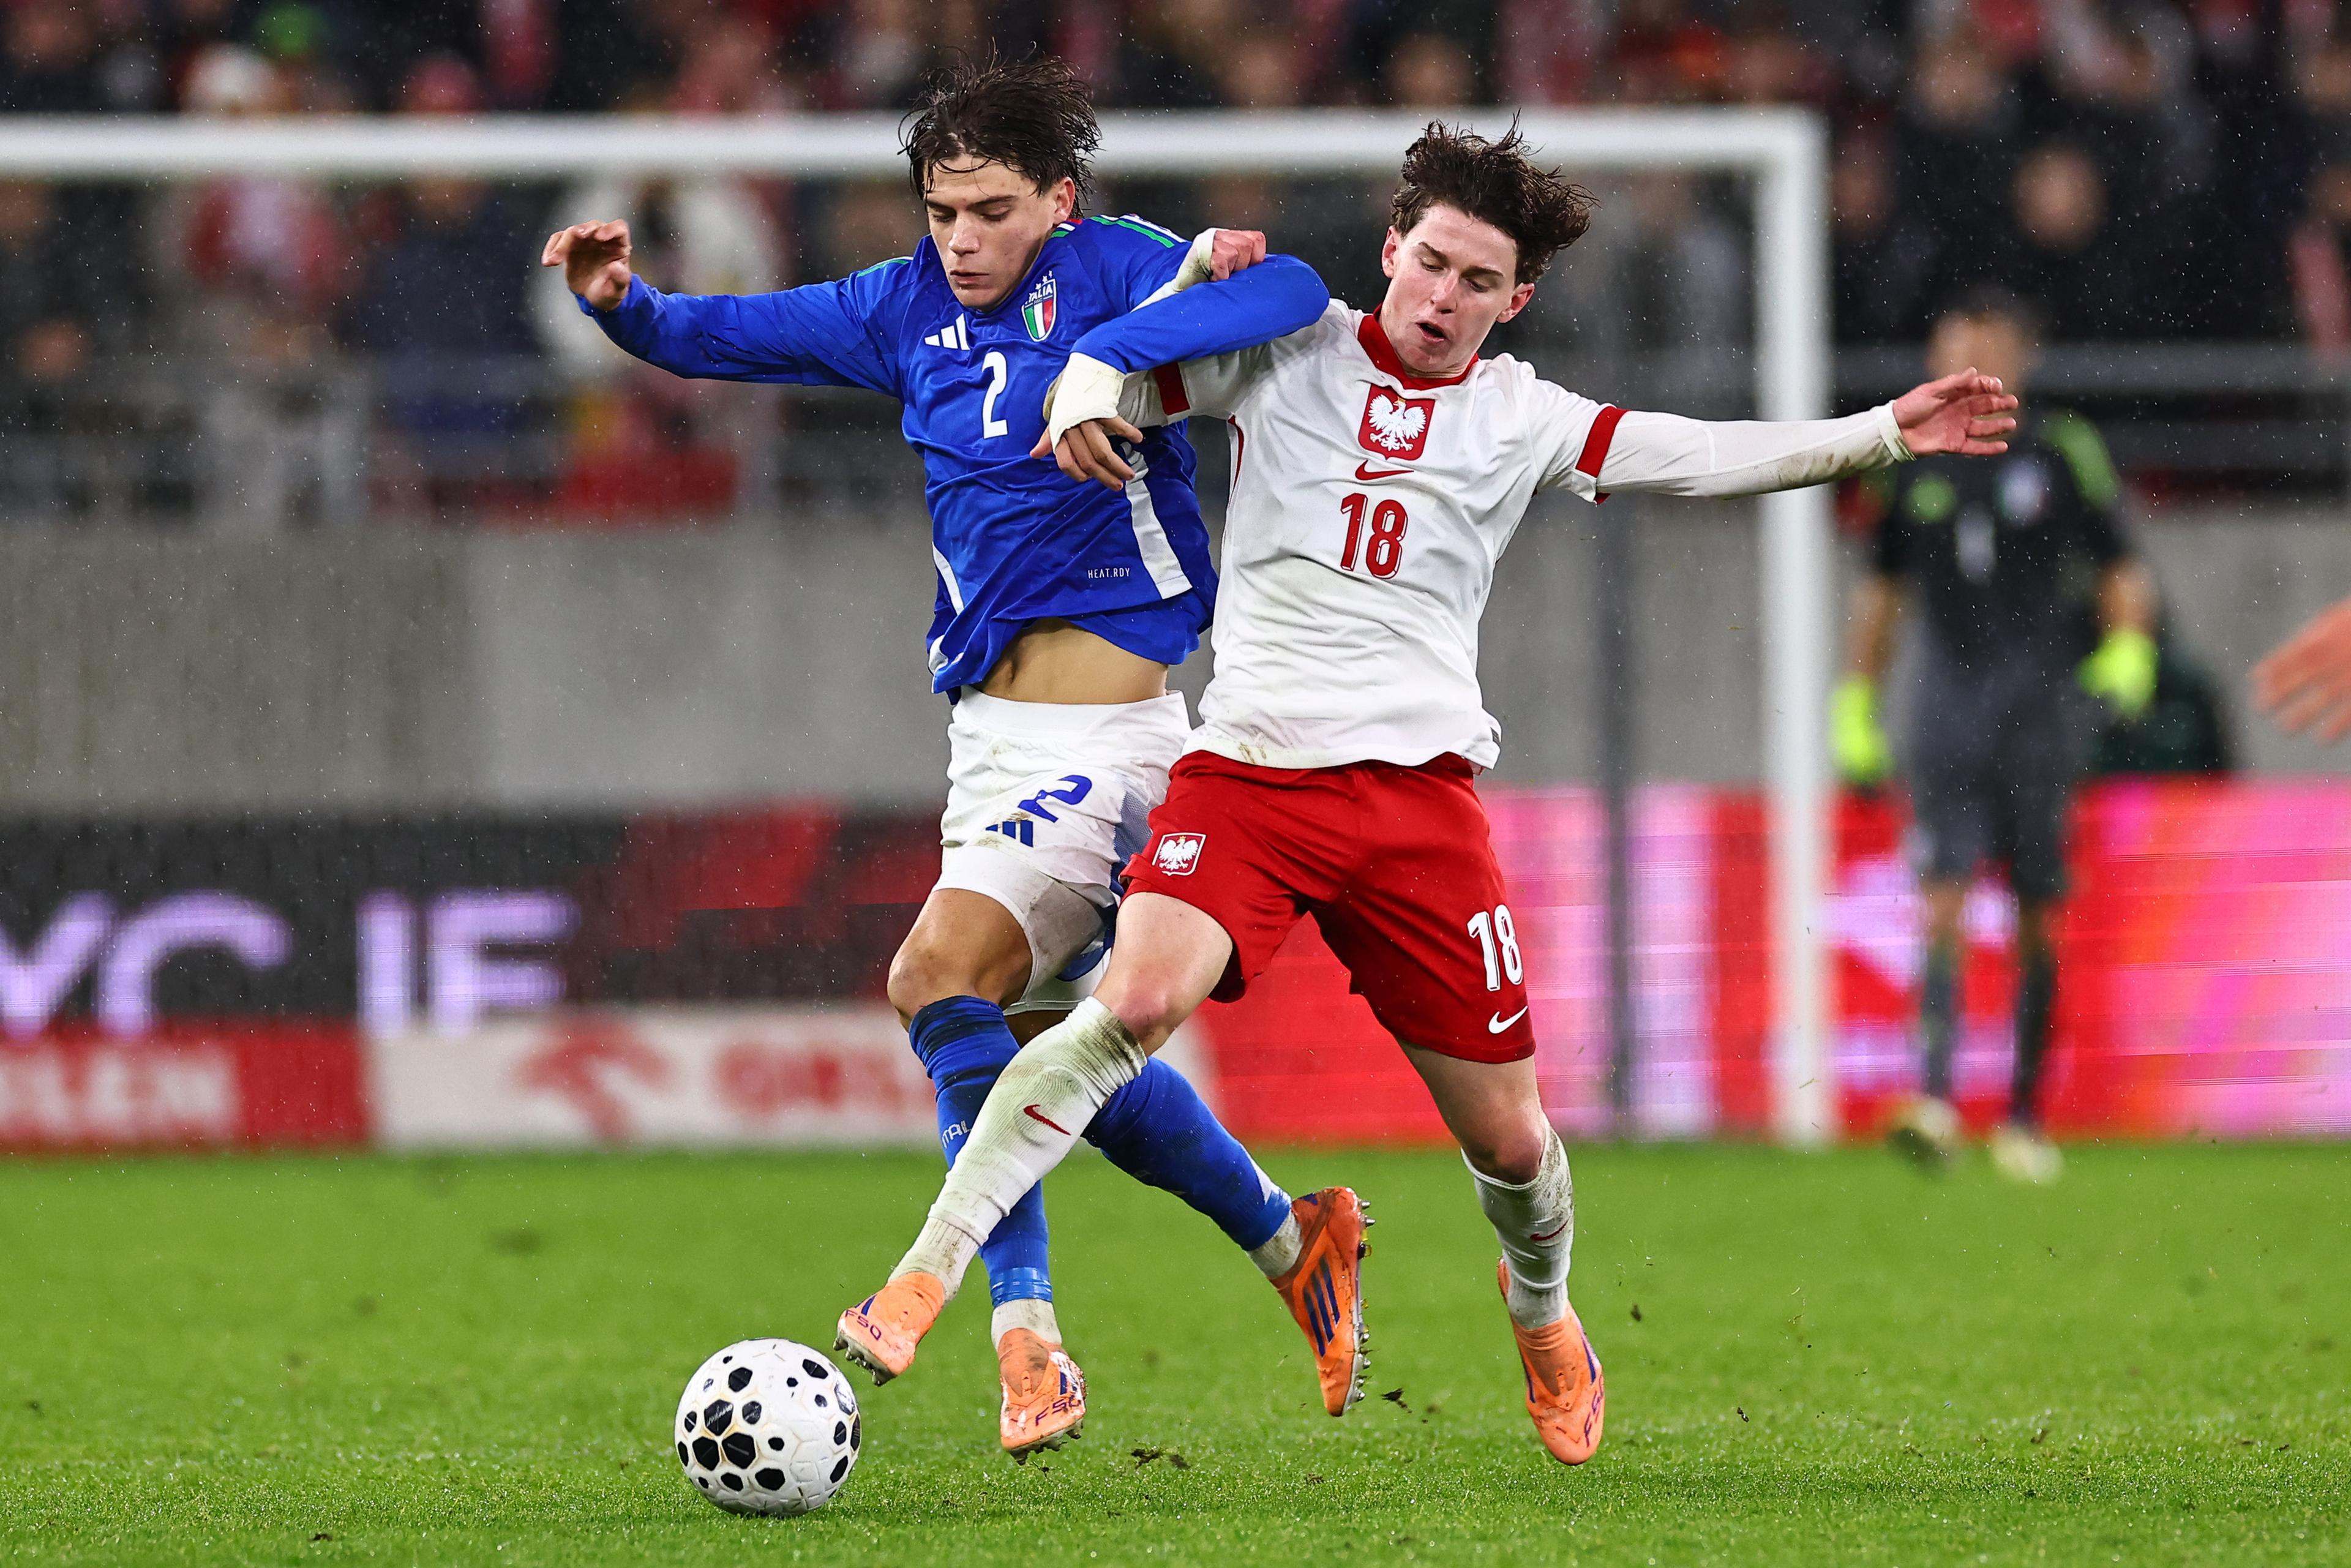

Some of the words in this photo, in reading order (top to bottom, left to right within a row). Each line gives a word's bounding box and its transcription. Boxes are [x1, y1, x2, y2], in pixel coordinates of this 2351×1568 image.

[981, 351, 1008, 440] 2
[1340, 492, 1408, 579] 18
[1087, 567, 1130, 579] HEAT.RDY
[1017, 774, 1093, 823] 2
[1467, 904, 1523, 992] 18
[845, 1309, 882, 1341] F50
[1035, 1394, 1082, 1427] F50
